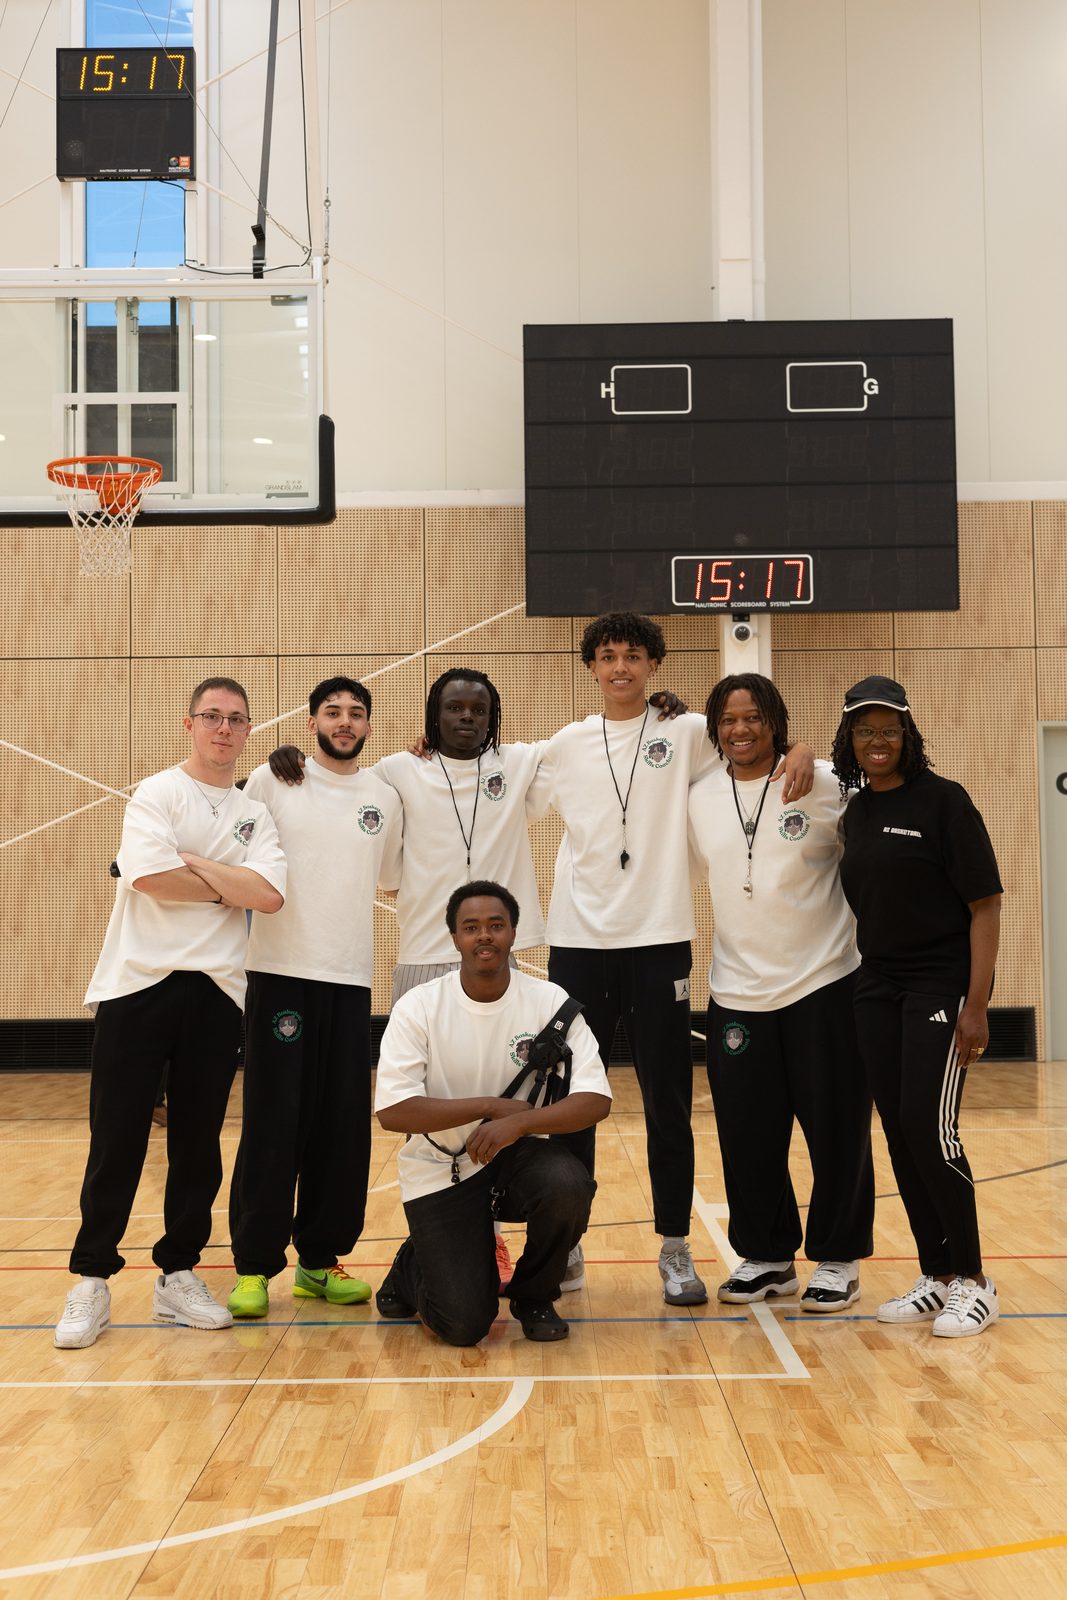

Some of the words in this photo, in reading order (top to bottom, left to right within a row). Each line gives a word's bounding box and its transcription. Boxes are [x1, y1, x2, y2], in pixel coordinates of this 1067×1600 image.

[79, 54, 185, 91] 15:17
[600, 382, 615, 399] H
[863, 378, 879, 395] G
[695, 560, 804, 601] 15:17
[509, 1051, 522, 1067] Skills
